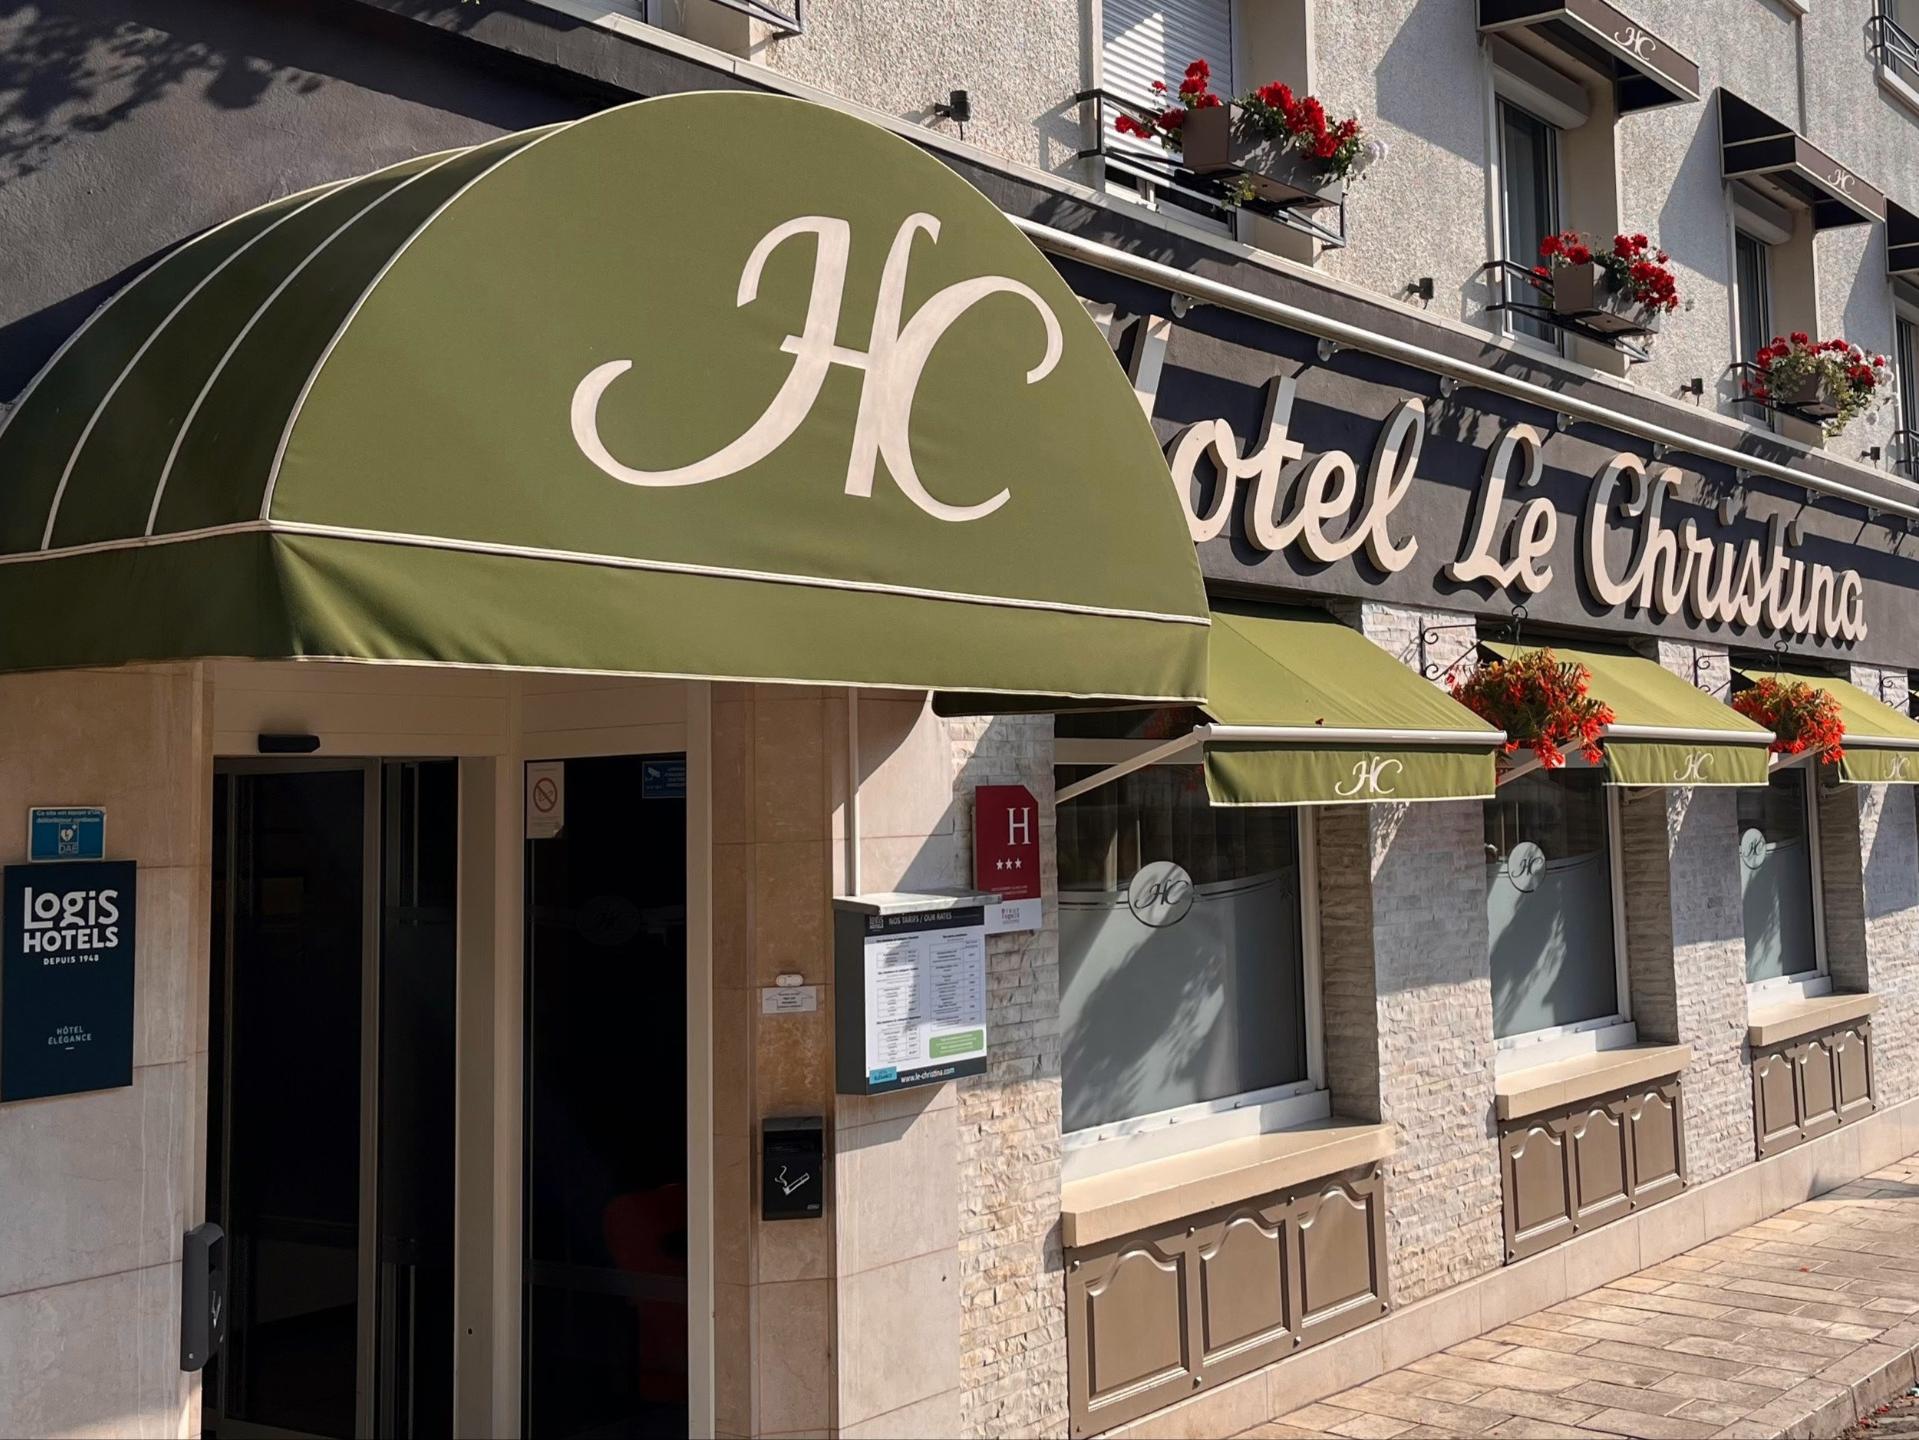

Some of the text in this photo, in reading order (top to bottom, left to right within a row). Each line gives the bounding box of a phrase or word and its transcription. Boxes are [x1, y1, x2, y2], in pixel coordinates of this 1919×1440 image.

[571, 212, 1064, 522] HC
[1444, 423, 1558, 594] Le
[1584, 451, 1868, 642] Christina
[1335, 756, 1403, 796] HC
[1007, 807, 1032, 846] H
[23, 926, 119, 953] HOTELS
[43, 953, 99, 966] DEPUIS 1948
